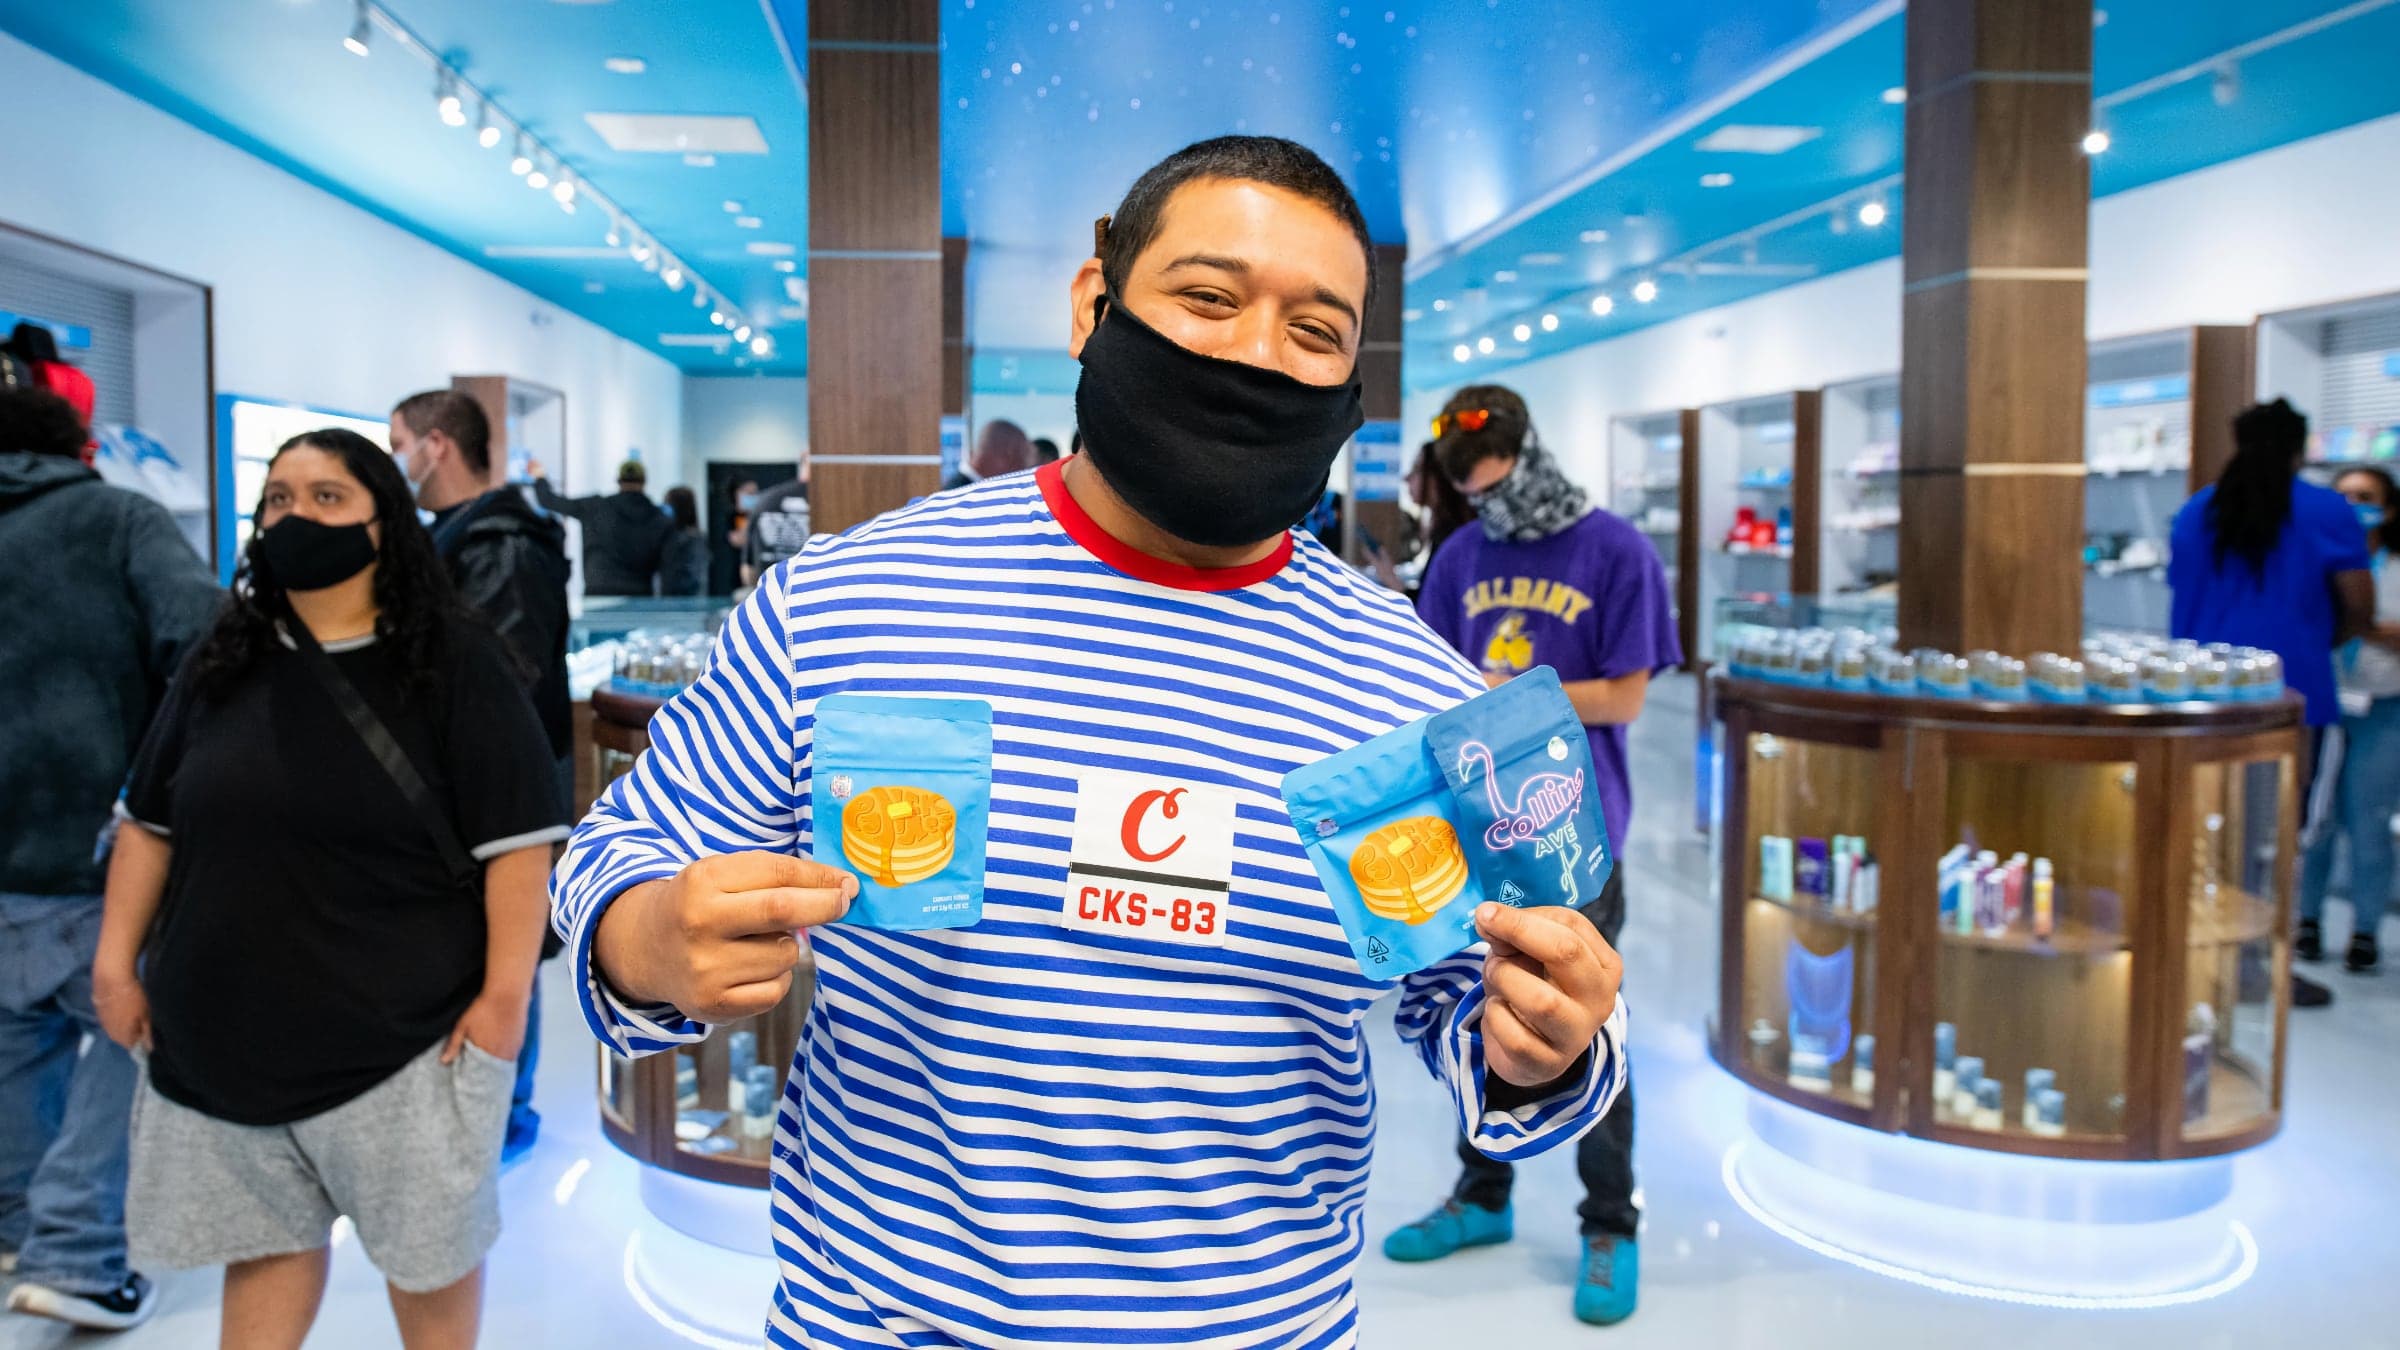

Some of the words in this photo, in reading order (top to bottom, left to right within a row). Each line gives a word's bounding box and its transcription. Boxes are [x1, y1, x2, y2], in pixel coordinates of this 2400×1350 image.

[1121, 788, 1189, 862] C
[1535, 822, 1578, 858] AVE
[1078, 886, 1216, 935] CKS-83
[1374, 955, 1389, 964] CA
